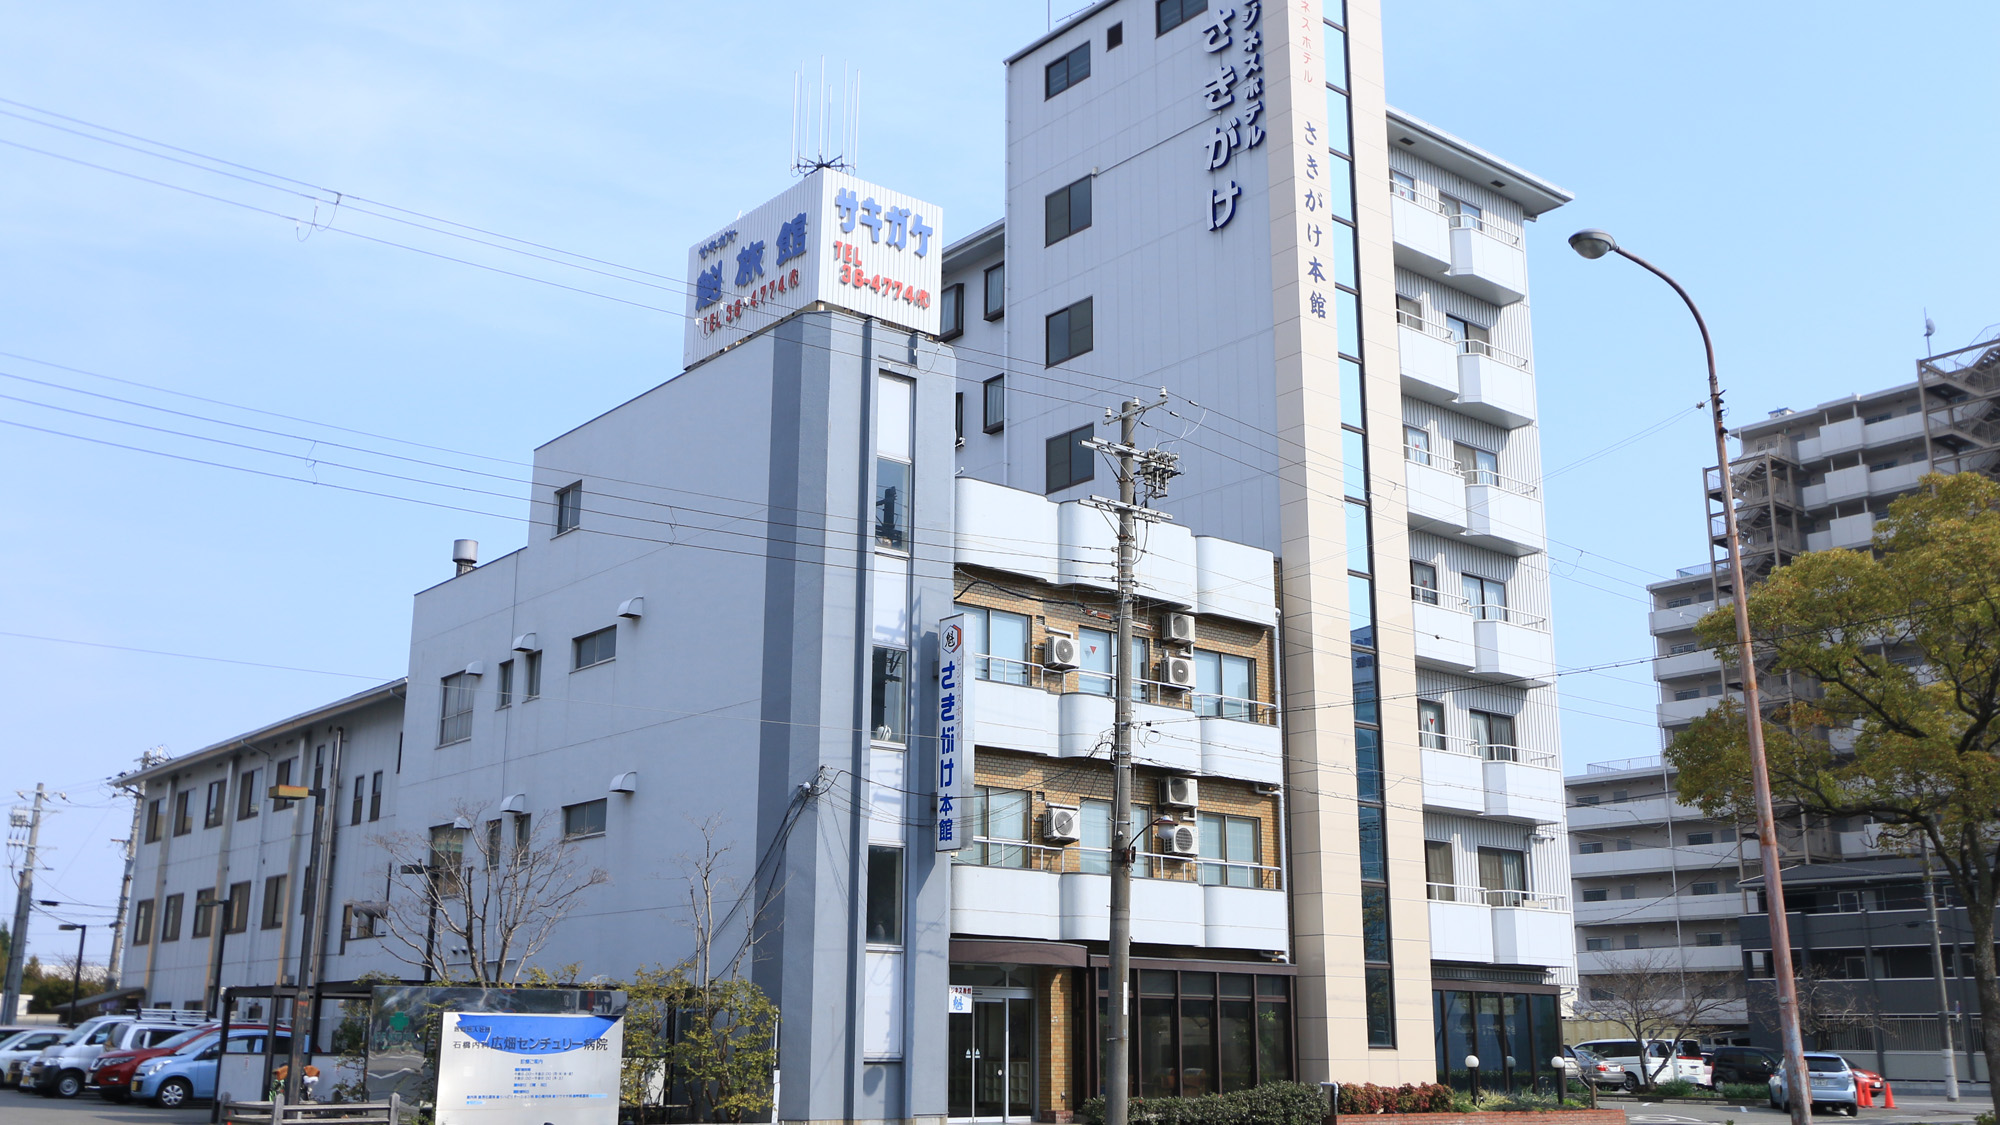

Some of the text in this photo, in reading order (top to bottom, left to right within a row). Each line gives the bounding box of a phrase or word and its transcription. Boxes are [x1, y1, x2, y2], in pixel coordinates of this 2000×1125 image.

[1203, 8, 1241, 231] さきがけ
[834, 240, 862, 267] TEL
[835, 187, 933, 258] サキガケ
[1304, 121, 1326, 319] さきがけ本館
[939, 660, 955, 841] さきがけ本館
[490, 1036, 608, 1051] 広畑センチュリー病院
